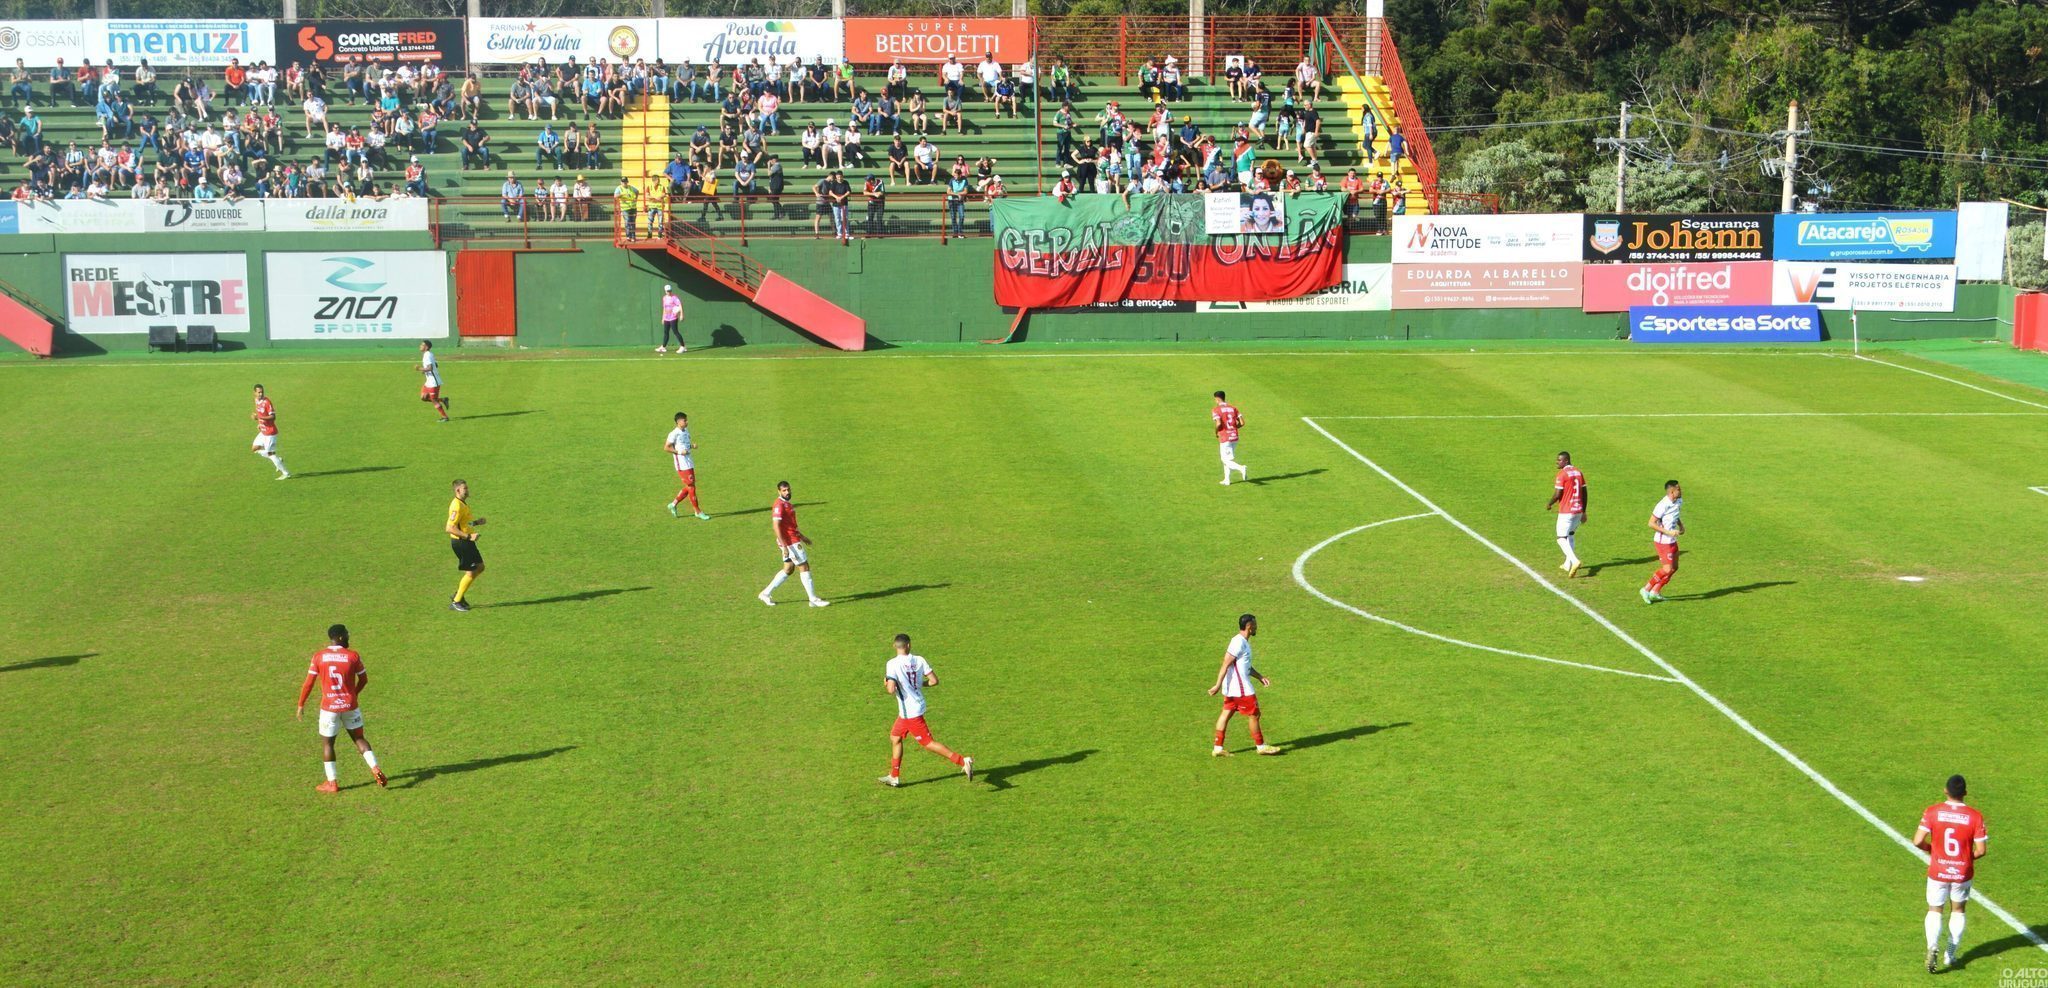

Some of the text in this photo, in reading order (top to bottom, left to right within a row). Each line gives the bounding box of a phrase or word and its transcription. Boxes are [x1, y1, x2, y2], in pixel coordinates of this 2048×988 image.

[726, 22, 763, 36] Posto
[907, 23, 968, 32] SUPER
[26, 35, 80, 47] OSSANI
[108, 22, 249, 53] menuzzi
[338, 32, 437, 46] CONCREFRED
[486, 33, 535, 50] Estrela
[875, 34, 999, 53] BERTOLETTI
[703, 32, 796, 62] Avenida
[305, 205, 388, 219] dalla nora
[1681, 219, 1760, 230] Segurança
[1433, 227, 1468, 237] NOVA
[1627, 221, 1763, 250] Johann
[1806, 222, 1887, 242] Atacarejo
[1001, 221, 1123, 277] GERAL
[1430, 238, 1481, 249] ATITUDE
[1645, 252, 1690, 260] 3744-3181
[71, 267, 119, 282] REDE
[1407, 268, 1568, 280] EDUARDA ALBARELLO
[1849, 272, 1949, 281] VISSOTTO ENGENHARIA
[1627, 265, 1731, 306] digifred
[1849, 281, 1893, 289] PROJETOS
[73, 279, 246, 317] MESTRE
[1122, 298, 1134, 307] da
[1316, 297, 1349, 305] ESPORTE!
[313, 296, 398, 320] ZACA
[313, 323, 392, 333] SPORTS
[1639, 315, 1811, 335] Esportes da Sorte
[1573, 478, 1580, 497] 3
[328, 665, 343, 691] 5
[1944, 827, 1960, 857] 6
